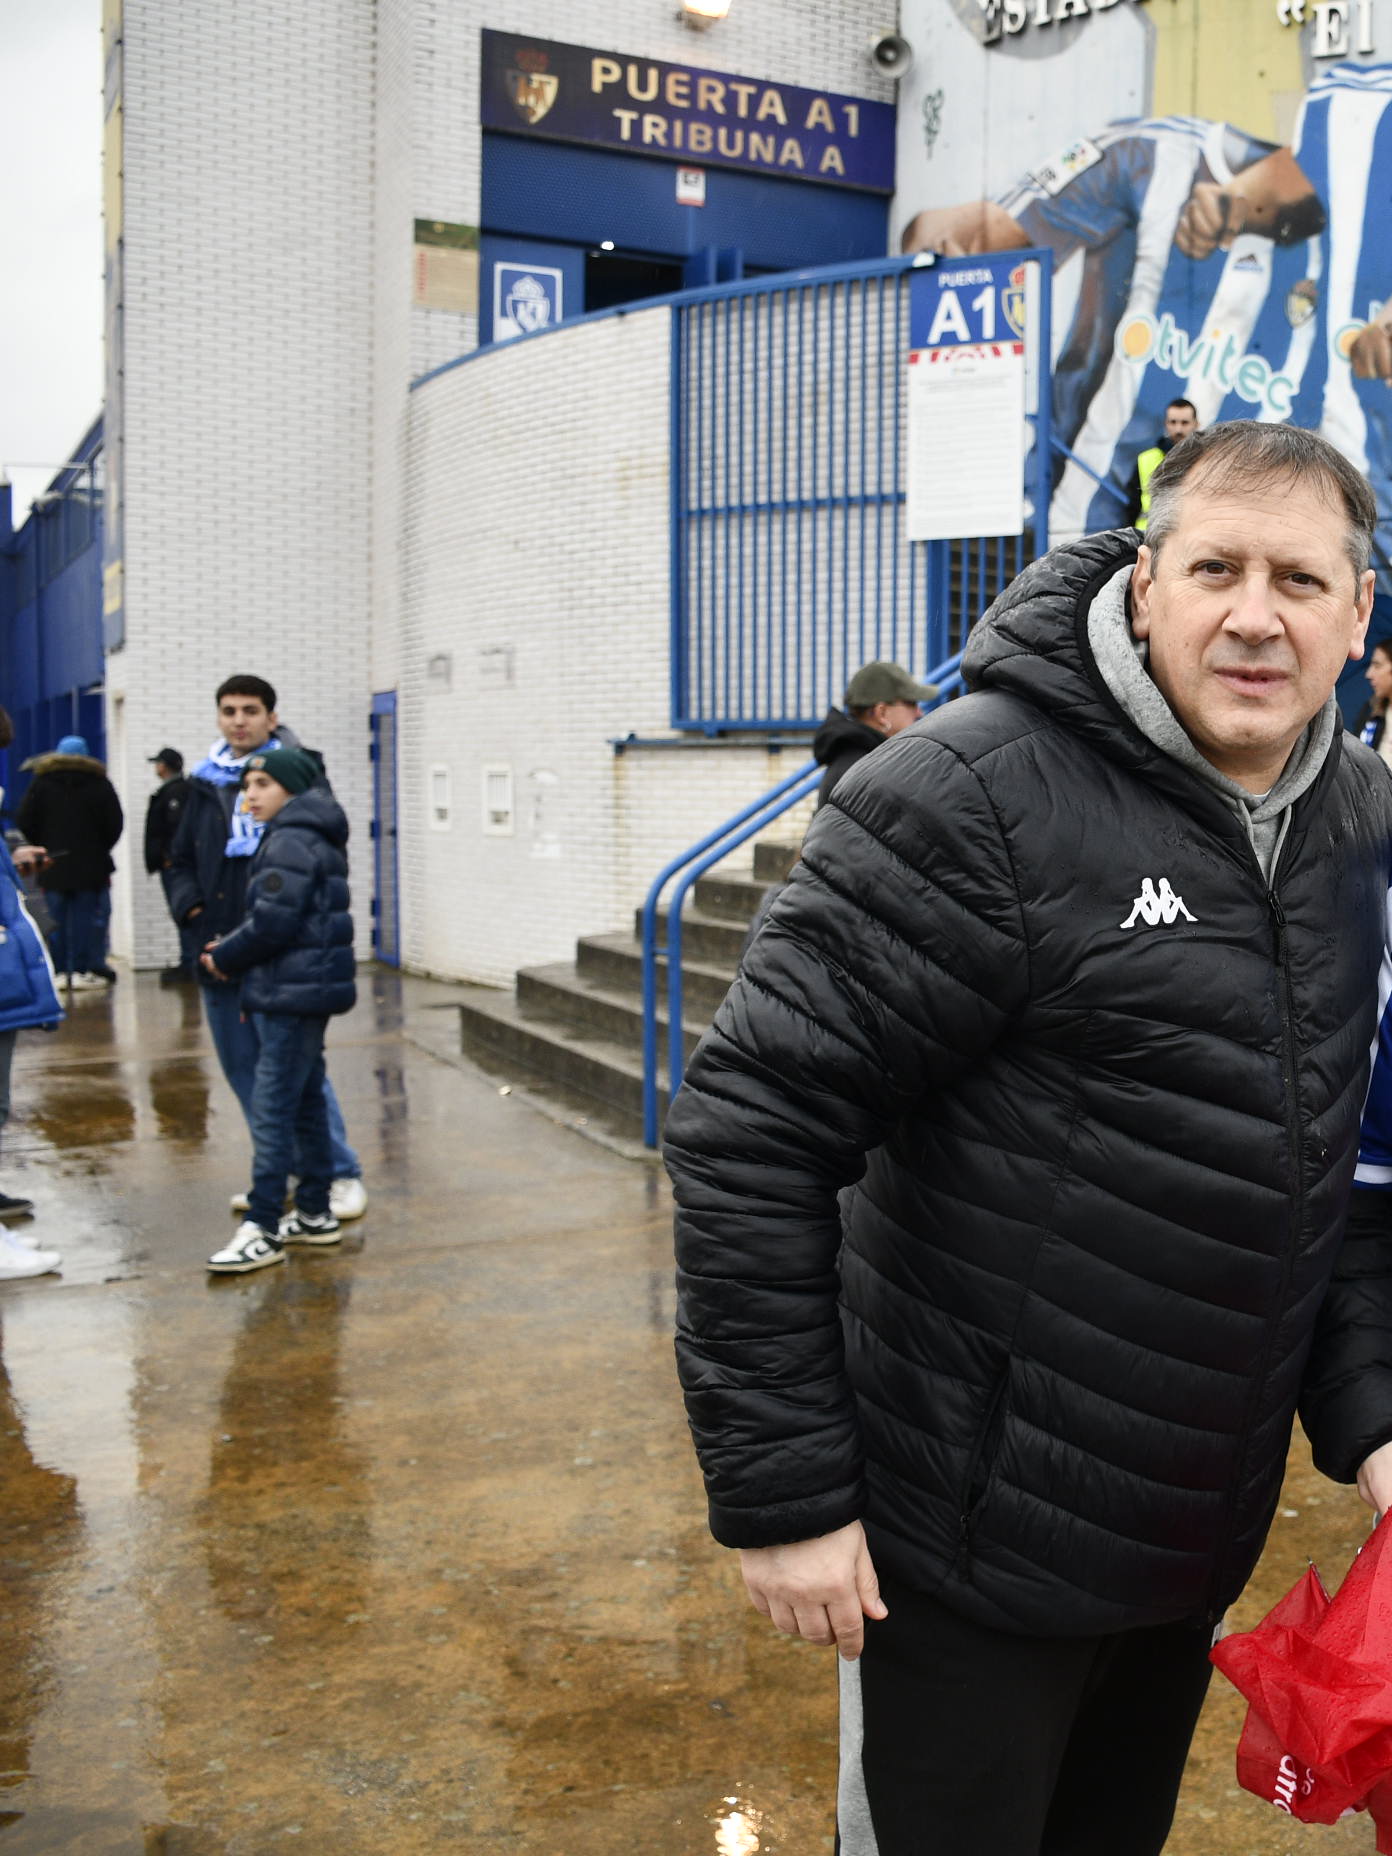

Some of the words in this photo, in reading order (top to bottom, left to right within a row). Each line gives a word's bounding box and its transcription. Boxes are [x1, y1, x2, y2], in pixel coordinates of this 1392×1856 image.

[590, 57, 788, 125] PUERTA
[805, 97, 860, 138] A1
[612, 108, 805, 169] TRIBUNA
[818, 145, 845, 176] A
[938, 268, 993, 287] PUERTA
[927, 286, 995, 344] A1
